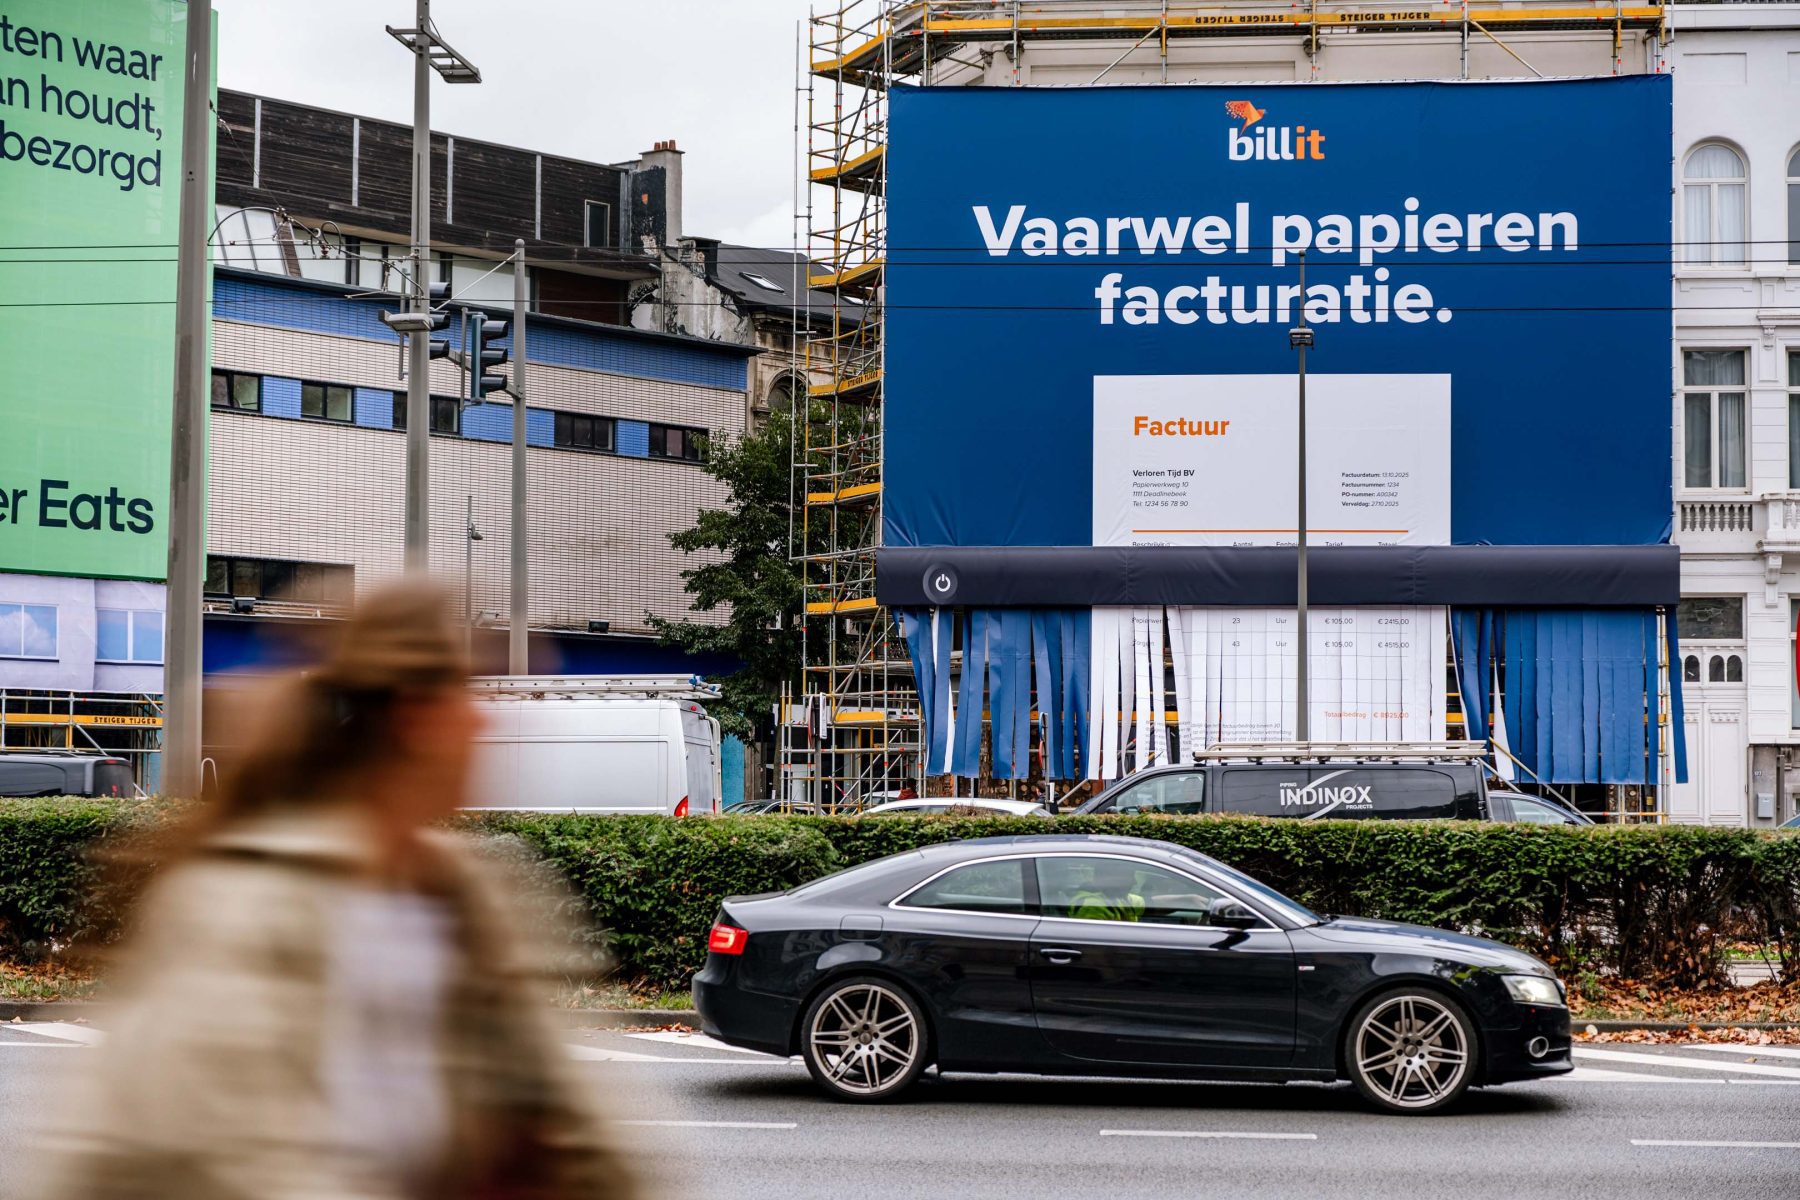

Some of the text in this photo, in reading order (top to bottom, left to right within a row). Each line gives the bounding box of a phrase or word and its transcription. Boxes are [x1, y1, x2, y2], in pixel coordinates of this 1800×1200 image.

[1195, 15, 1284, 24] STEIGER TIJGER
[1340, 12, 1430, 21] STEIGER TIJGER
[72, 37, 163, 81] waar
[0, 74, 162, 141] n houdt,
[0, 120, 161, 191] bezorgd
[1228, 126, 1326, 162] billit
[972, 197, 1579, 267] Vaarwel papieren
[1094, 267, 1453, 325] facturatie.
[1133, 416, 1230, 436] Factuur
[1132, 469, 1195, 479] Verloren Tijd BV
[1132, 481, 1181, 489] Papierwerkweg
[0, 479, 154, 534] r Eats
[94, 716, 157, 725] STEIGER TIJGER
[1280, 786, 1373, 806] INDINOX
